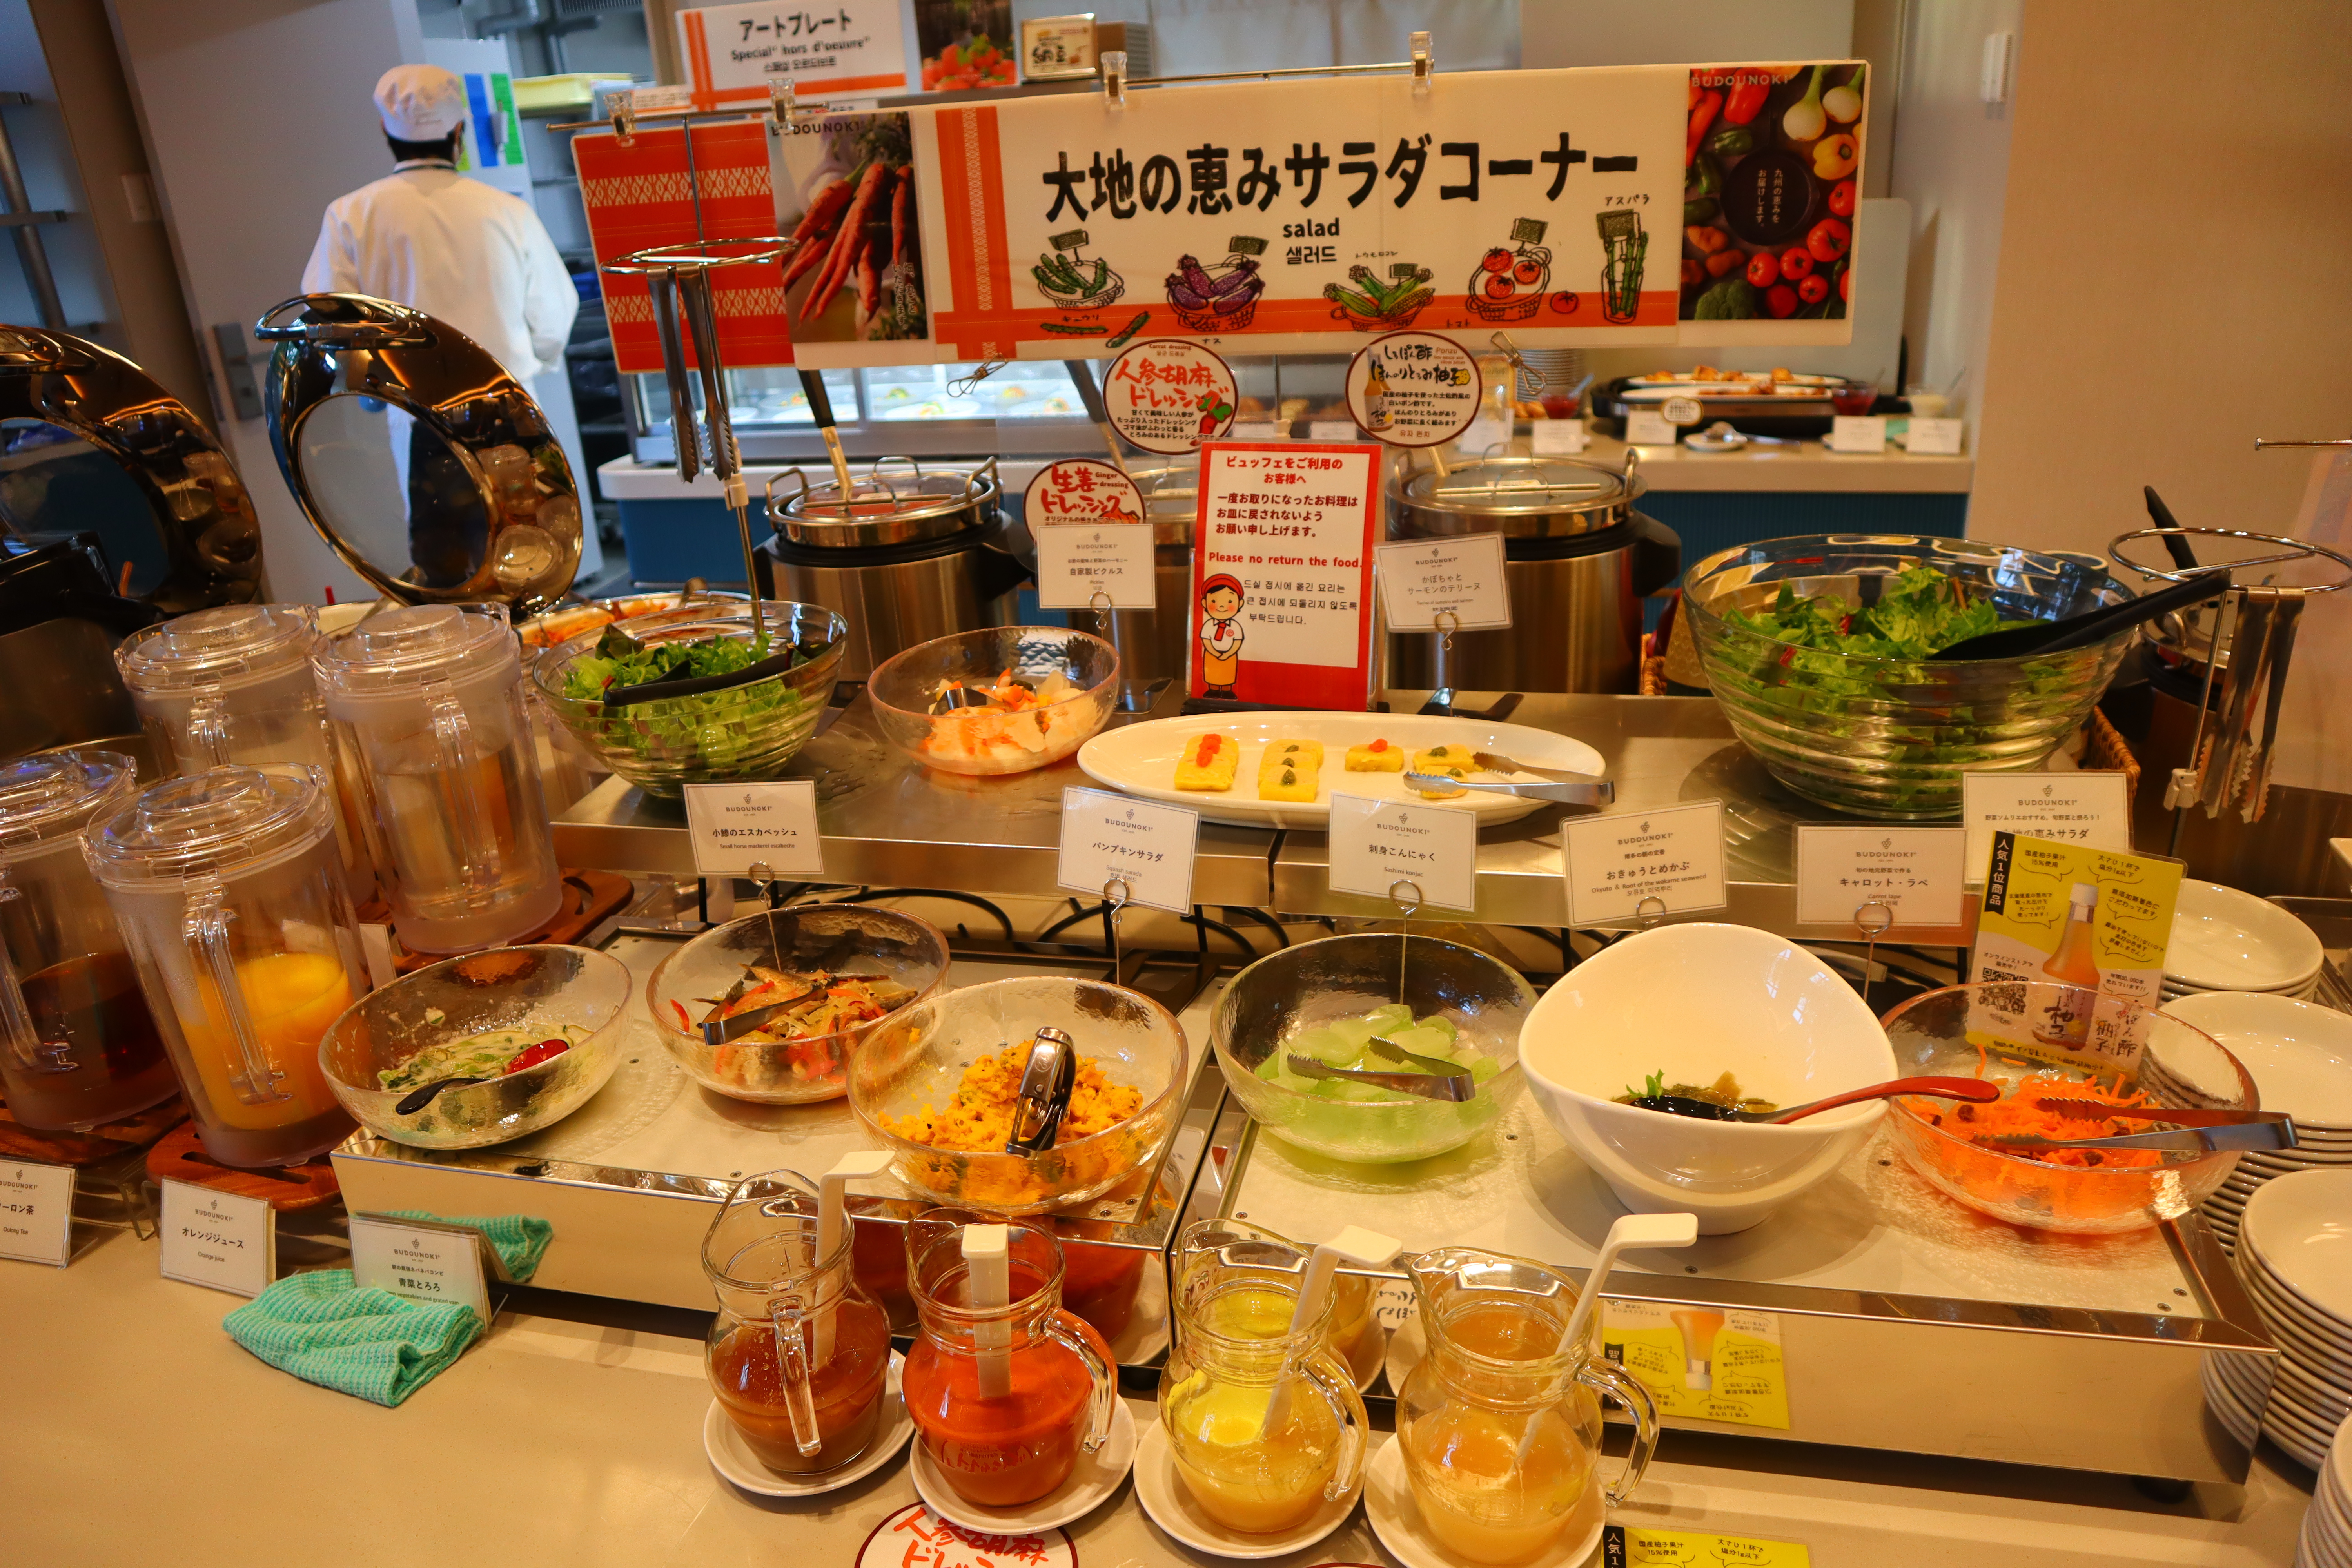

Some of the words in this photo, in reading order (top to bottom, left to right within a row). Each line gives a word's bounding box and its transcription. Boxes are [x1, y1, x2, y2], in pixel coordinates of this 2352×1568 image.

[740, 9, 852, 39] アートプレート
[781, 44, 807, 55] hors
[771, 122, 861, 136] BDOUNOKI
[1043, 132, 1637, 223] 大地の恵みサラダコーナー
[1605, 194, 1650, 206] アスパラ
[1283, 217, 1340, 238] salad
[1286, 246, 1337, 264] 샐러드
[1063, 314, 1100, 323] キュウリ
[1385, 343, 1433, 360] しろぽん酢
[1115, 357, 1217, 388] 人参胡麻
[1130, 383, 1230, 411] ドレッシング
[1227, 456, 1343, 470] ビュッフェをご利用の
[1051, 464, 1098, 493] 生姜
[1099, 481, 1129, 489] dressing
[1264, 472, 1307, 484] お客様へ
[1041, 488, 1127, 514] ドレッシング
[1218, 492, 1358, 507] 一度お取りになったお料理は
[1216, 508, 1323, 522] お皿に戻されないよう
[1216, 523, 1316, 537] お願い申し上げます。
[1209, 552, 1243, 563] Please
[1268, 555, 1303, 566] return
[1309, 556, 1327, 567] the
[1333, 557, 1363, 568] food.
[1070, 567, 1123, 575] 自家製ピクルス
[1422, 573, 1462, 583] かぼちゃと
[1244, 579, 1261, 589] 드실
[1265, 581, 1292, 590] 접시에
[1296, 582, 1314, 592] 옮긴
[1318, 583, 1345, 593] 요리는
[1407, 583, 1481, 595] サーモンのテリーヌ
[1259, 597, 1285, 607] 접시에
[1330, 601, 1357, 611] 않도록
[1249, 613, 1307, 625] 부탁드립니다.
[1093, 842, 1164, 862] パンプキンサラダ
[1369, 844, 1435, 862] 刺身こんにゃく
[2025, 849, 2066, 861] 国産柚子果汁
[1106, 865, 1124, 873] Squash
[2031, 858, 2058, 868] 15%使用
[1406, 869, 1423, 877] konjac
[1606, 861, 1690, 880] おきゅうとめかぶ
[1989, 839, 2009, 905] 人気1位商品
[1592, 886, 1612, 894] Okyuto
[1681, 873, 1707, 882] seaweed
[0, 1203, 34, 1215] ーロン茶
[182, 1227, 244, 1249] オレンジジュース
[198, 1251, 214, 1260] Orange
[398, 1278, 440, 1292] 青菜とろろ
[1608, 1532, 1621, 1568] 人気1
